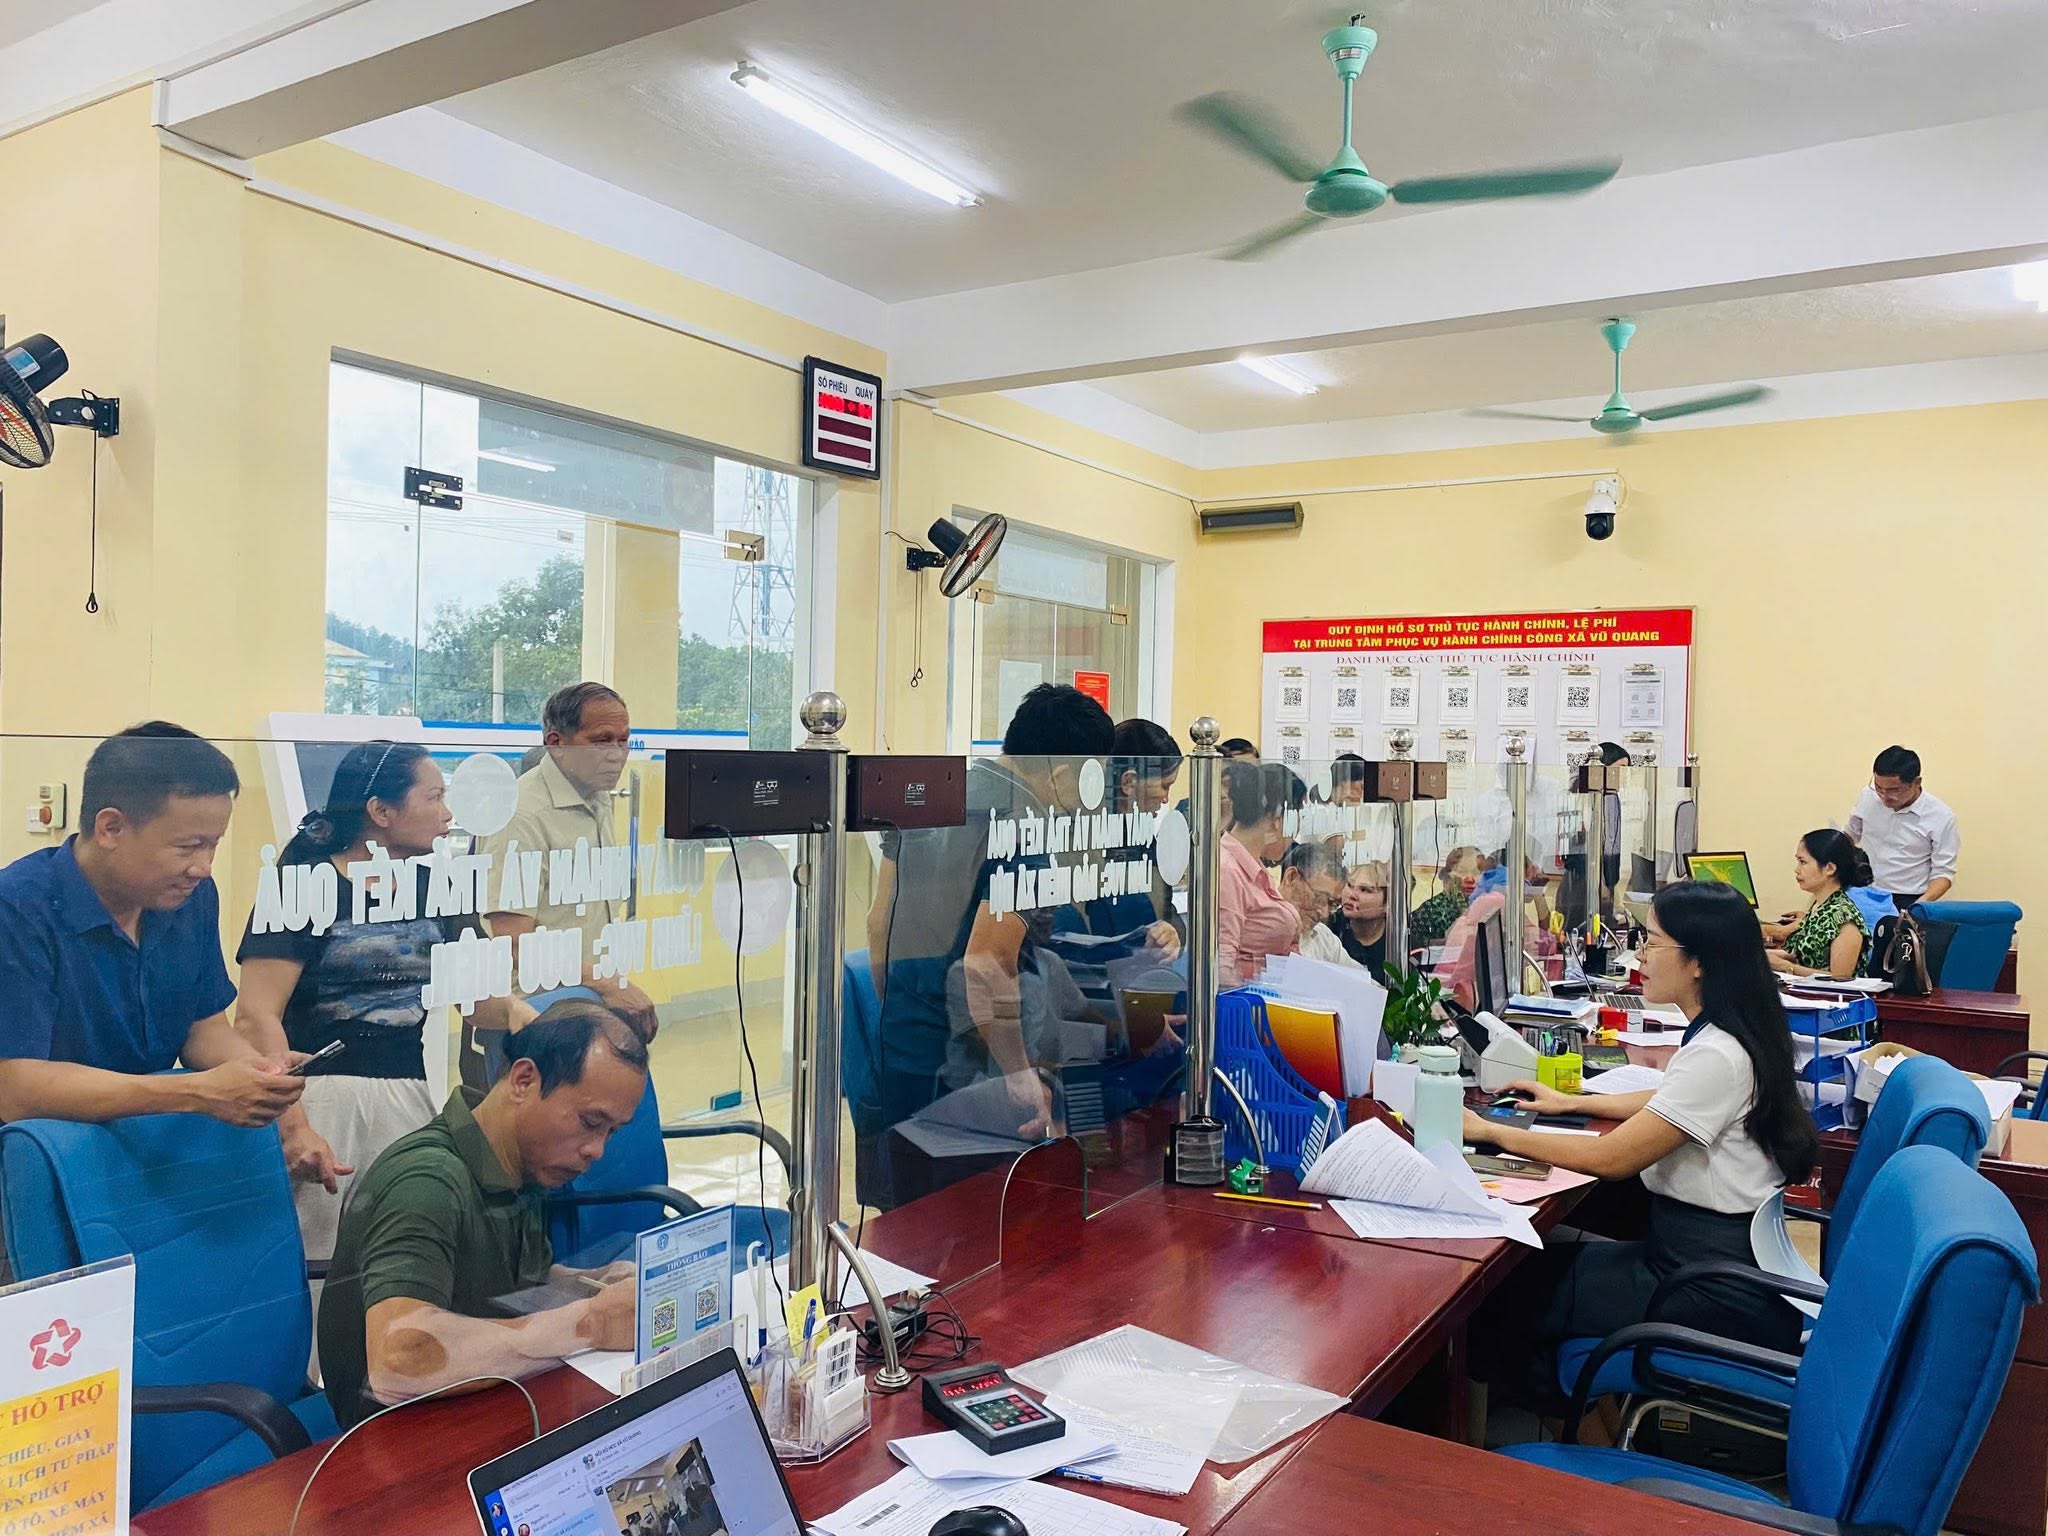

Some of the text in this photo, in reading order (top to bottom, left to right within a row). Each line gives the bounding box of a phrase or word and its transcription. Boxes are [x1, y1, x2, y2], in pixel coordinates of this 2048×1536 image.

[1328, 625, 1351, 635] QUY
[1355, 625, 1384, 636] ĐỊNH
[1408, 623, 1425, 633] SƠ
[1428, 620, 1452, 632] THỦ
[1456, 622, 1480, 633] TỤC
[1484, 618, 1519, 630] HÀNH
[1574, 617, 1589, 630] LỆ
[1594, 616, 1617, 628] PHÍ
[1293, 631, 1660, 649] TẠI TRUNG TÂM PHỤC VỤ HÀNH CHÍNH CÔNG XÃ VŨ QUANG
[1336, 656, 1371, 664] DANH
[1408, 654, 1433, 663] CÁC
[1439, 653, 1465, 663] THỦ
[1503, 652, 1542, 662] HÀNH
[1547, 651, 1595, 662] CHÍNH
[12, 1381, 104, 1425] HỖ TRỢ
